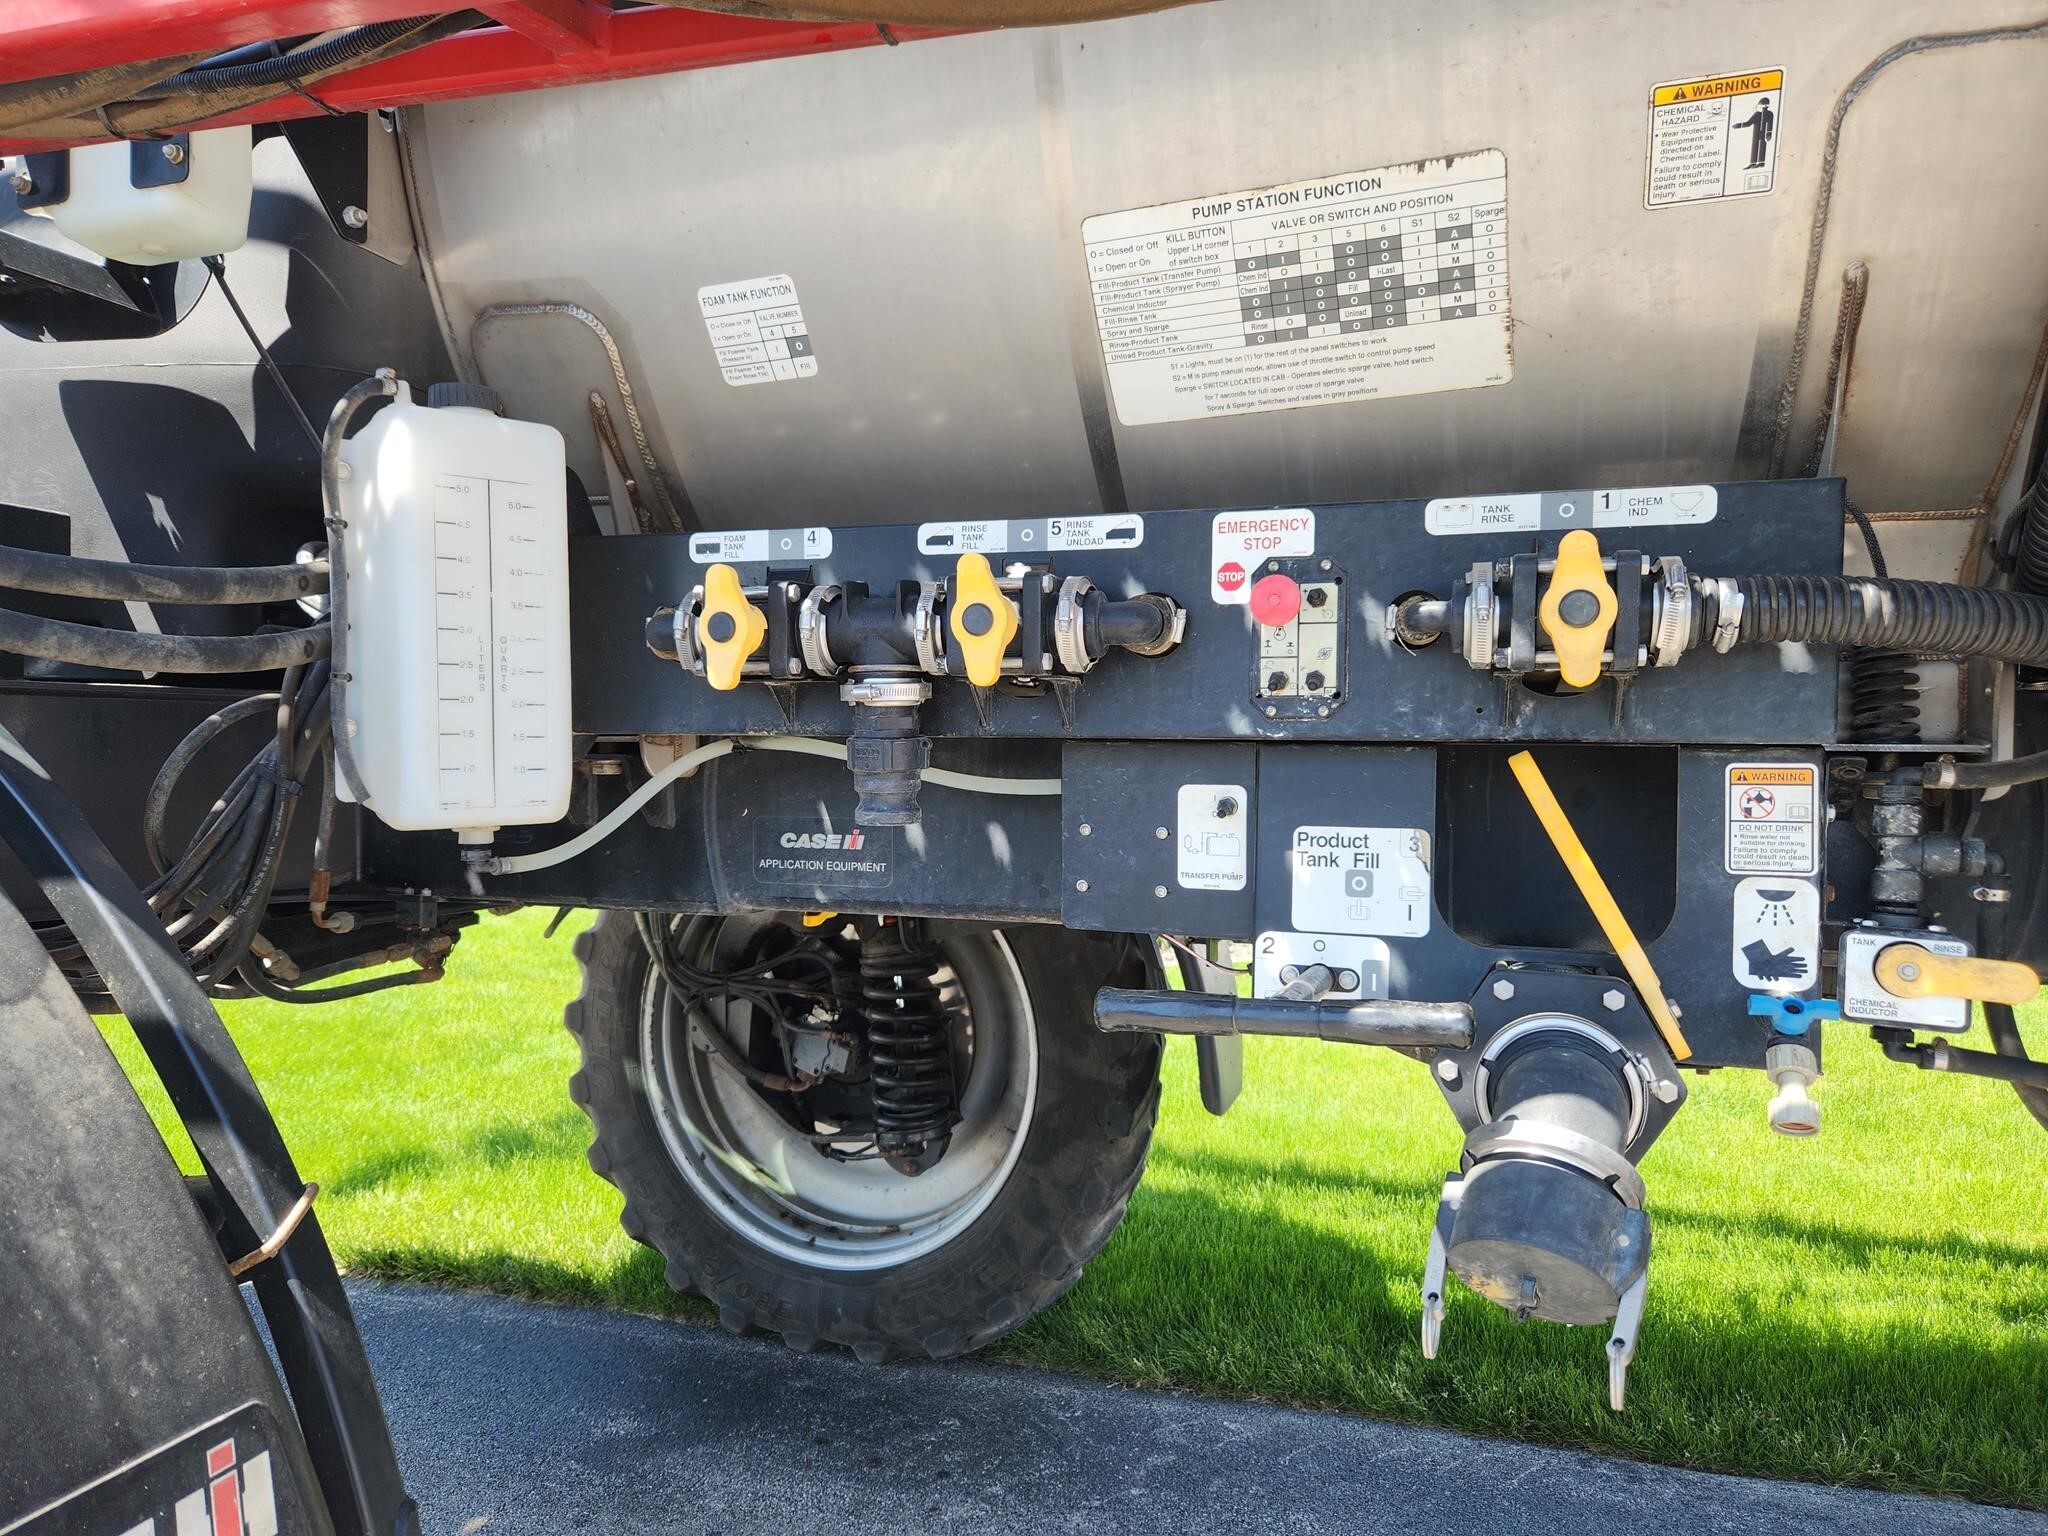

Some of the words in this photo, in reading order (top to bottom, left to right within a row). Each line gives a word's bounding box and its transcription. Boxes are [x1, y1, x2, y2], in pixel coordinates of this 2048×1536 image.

[75, 69, 112, 89] MADE
[1692, 77, 1761, 96] WARNING
[1657, 105, 1706, 118] CHEMICAL
[1662, 115, 1699, 126] HAZARD
[1662, 129, 1679, 138] Wear
[1681, 126, 1717, 136] Protective
[1661, 135, 1702, 147] Equipment
[1660, 145, 1691, 154] directed
[1660, 153, 1696, 163] Chemical
[1698, 150, 1722, 159] Label.
[1654, 165, 1680, 174] Failure
[1692, 161, 1722, 170] comply
[1653, 173, 1676, 182] could
[1679, 170, 1702, 179] result
[1653, 181, 1676, 191] death
[1689, 177, 1720, 187] serious
[1192, 202, 1232, 219] PUMP
[1236, 190, 1300, 212] STATION
[1304, 177, 1382, 201] FUNCTION
[1653, 191, 1677, 200] injury.
[1272, 217, 1306, 230] VALVE
[1310, 214, 1325, 224] OR
[1328, 207, 1370, 221] SWITCH
[1374, 203, 1397, 214] AND
[1400, 193, 1453, 209] POSITION
[1412, 219, 1423, 227] S1
[1448, 213, 1460, 221] S2
[1475, 207, 1505, 218] Sparge
[1166, 235, 1185, 243] KILL
[1188, 227, 1226, 240] BUTTON
[1106, 245, 1133, 256] Closed
[1146, 241, 1158, 250] Off
[1167, 245, 1190, 255] Upper
[1192, 243, 1203, 251] LH
[1205, 240, 1229, 249] corner
[1105, 262, 1126, 272] Open
[1140, 259, 1151, 267] On
[1179, 255, 1203, 265] switch
[1098, 279, 1140, 290] Fill-Product
[1142, 275, 1159, 283] Tank
[1161, 271, 1195, 281] (Transfer
[1196, 266, 1221, 276] Pump)
[702, 294, 726, 307] FOAM
[728, 291, 750, 304] TANK
[750, 284, 792, 300] FUNCTION
[1100, 292, 1141, 302] Fill-Product
[1162, 282, 1194, 295] (Sprayer
[1196, 279, 1221, 290] Pump)
[1102, 303, 1135, 315] Chemical
[1137, 300, 1167, 309] Inductor
[759, 312, 775, 321] VALVE
[1104, 315, 1138, 326] Fill-Rinse
[1107, 329, 1127, 338] Spray
[1144, 324, 1169, 332] Sparge
[1345, 309, 1367, 317] Unload
[1109, 338, 1159, 350] Rinse-Product
[1392, 347, 1412, 355] pump
[1414, 344, 1435, 352] speed
[1111, 351, 1136, 360] Unload
[1138, 348, 1165, 357] Product
[1167, 342, 1213, 354] Tank-Gravity
[1203, 381, 1228, 390] SWITCH
[1230, 377, 1261, 387] LOCATED
[1291, 370, 1320, 379] Operates
[1322, 366, 1346, 375] electric
[1348, 364, 1371, 373] sparge
[1258, 398, 1286, 406] Switches
[1348, 387, 1378, 396] positions
[456, 485, 469, 493] 5.0
[508, 502, 521, 510] 5.0
[1601, 492, 1609, 509] 1
[1628, 497, 1663, 507] CHEM
[1481, 504, 1510, 514] TANK
[1628, 507, 1648, 516] IND
[1066, 520, 1094, 528] RINSE
[1481, 514, 1514, 523] RINSE
[961, 525, 988, 533] RINSE
[1051, 521, 1061, 535] 5
[1218, 517, 1309, 534] EMERGENCY
[807, 530, 816, 544] 4
[1066, 537, 1104, 546] UNLOAD
[1244, 537, 1282, 550] STOP
[510, 569, 523, 577] 4.0
[1218, 572, 1244, 582] STOP
[458, 591, 472, 599] 3.5
[460, 661, 473, 669] 2.5
[478, 635, 486, 692] LITERS
[500, 636, 508, 692] QUARTS
[460, 696, 474, 704] 2.0
[462, 730, 475, 738] 1.5
[1751, 773, 1806, 782] WARNING
[780, 832, 843, 850] CASE
[1297, 832, 1370, 849] Product
[1409, 836, 1420, 852] 3
[760, 859, 823, 870] APPLICATION
[826, 861, 886, 872] EQUIPMENT
[1297, 851, 1340, 868] Tank
[1354, 853, 1379, 869] Fill
[1181, 872, 1220, 880] TRANSFER
[1262, 937, 1275, 954] 2
[1852, 938, 1876, 946] TANK
[1933, 944, 1962, 953] RINSE
[1849, 998, 1898, 1009] CHEMICAL
[1849, 1007, 1898, 1017] INDUCTOR
